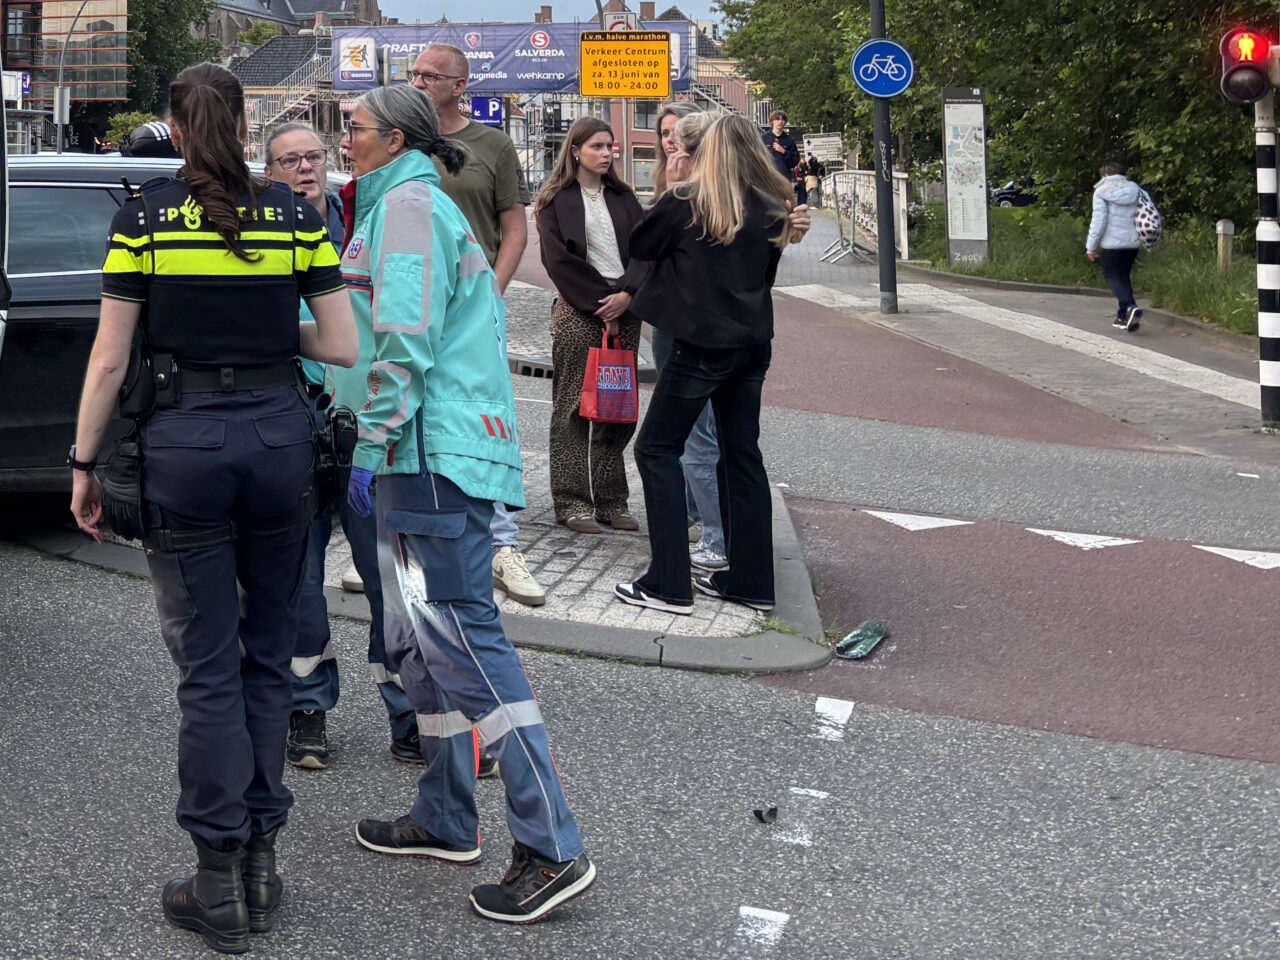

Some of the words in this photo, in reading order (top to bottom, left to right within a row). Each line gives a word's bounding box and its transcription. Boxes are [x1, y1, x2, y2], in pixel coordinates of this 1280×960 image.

[515, 49, 565, 57] SALVERDA
[585, 47, 622, 56] Verkeer
[625, 47, 666, 56] Centrum
[592, 59, 644, 68] afgesloten
[470, 71, 507, 81] rugmedia
[517, 72, 565, 80] wehkamp
[620, 70, 640, 80] juni
[489, 101, 500, 117] P
